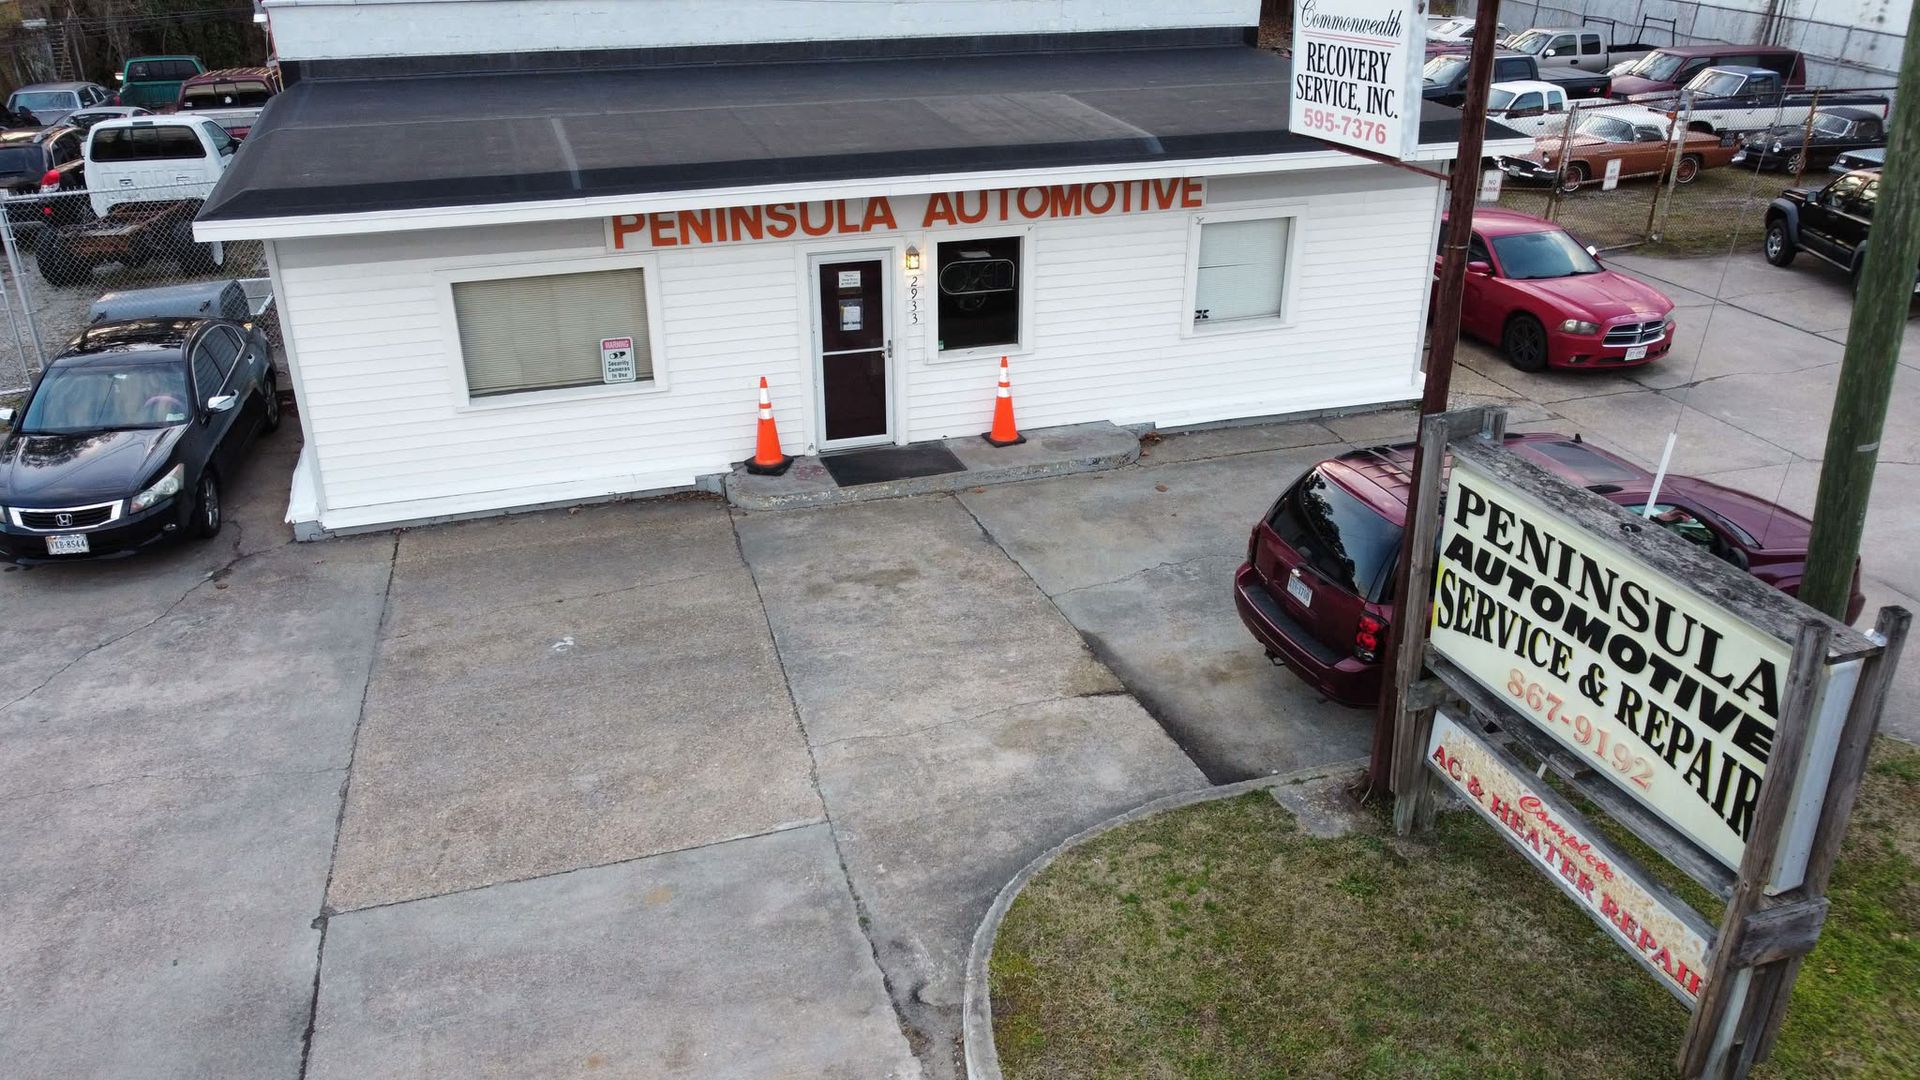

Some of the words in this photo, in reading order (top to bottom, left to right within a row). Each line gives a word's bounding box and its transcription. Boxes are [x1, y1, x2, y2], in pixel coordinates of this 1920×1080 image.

[1300, 0, 1402, 38] Commonwealth
[1306, 41, 1391, 84] RECOVERY
[1296, 74, 1361, 116] SERVICE,
[1366, 86, 1398, 119] INC.
[1304, 108, 1387, 144] 595-7376
[612, 195, 898, 249] PENINSULA
[922, 176, 1203, 227] AUTOMOTIVE
[1453, 483, 1779, 720] PENINSULA
[1444, 533, 1775, 765] AUTOMOTIVE
[1437, 567, 1573, 682] SERVICE
[1578, 662, 1609, 707] &
[1614, 681, 1763, 844] REPAIR
[1507, 667, 1658, 791] 867-9192
[1432, 745, 1463, 781] AC
[1467, 776, 1485, 803] &
[1490, 792, 1597, 903] HEATER
[1519, 795, 1614, 882] Complete
